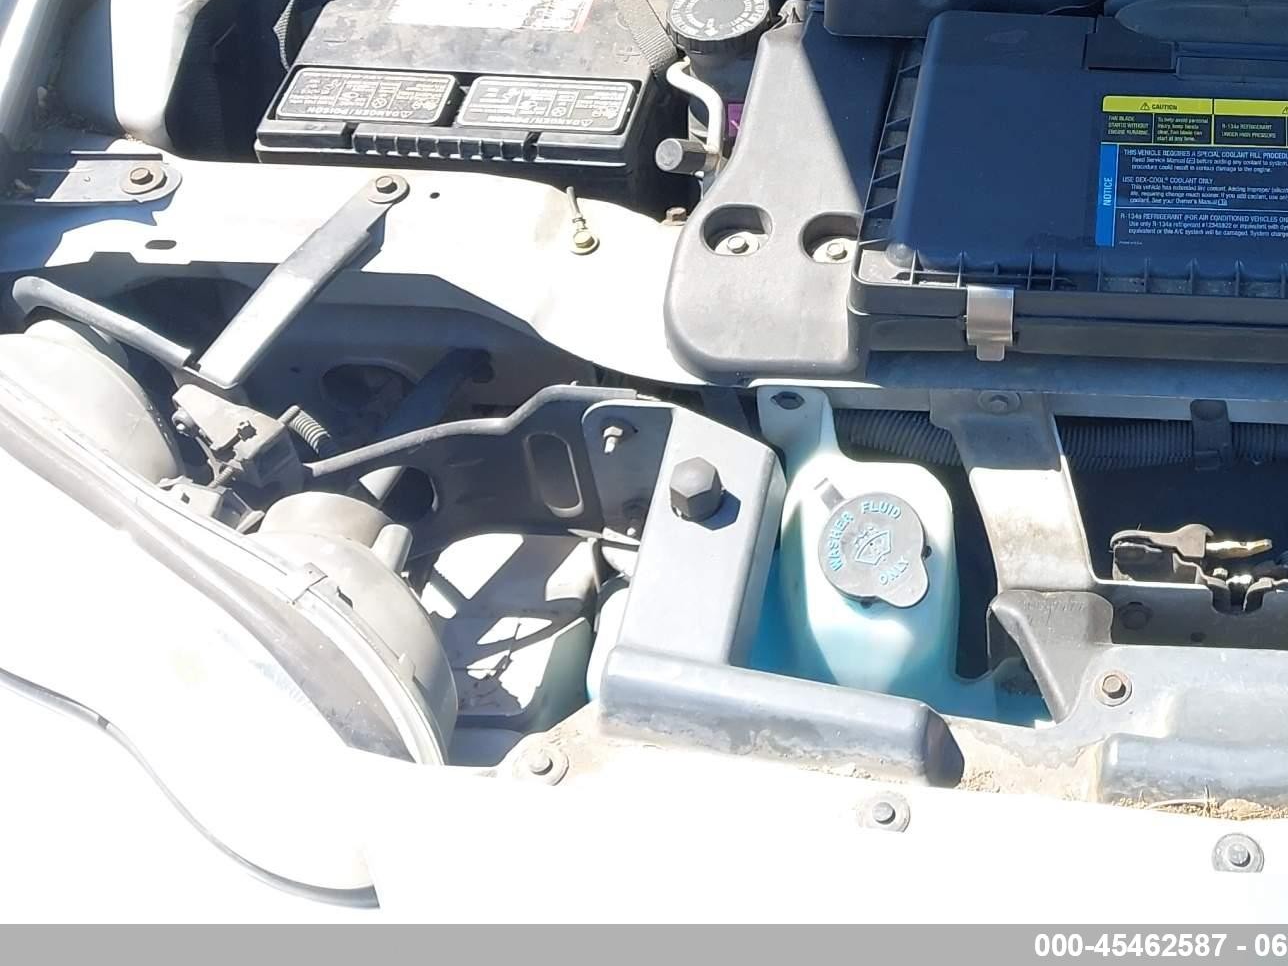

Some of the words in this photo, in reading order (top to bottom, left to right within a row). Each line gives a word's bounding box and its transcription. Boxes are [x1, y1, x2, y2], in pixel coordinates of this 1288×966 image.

[1103, 177, 1113, 206] NOTICE
[1210, 214, 1250, 222] CONDITIONED
[1250, 215, 1278, 223] VEHICLES
[861, 501, 901, 520] FLUID
[828, 511, 854, 572] WASHER
[880, 556, 909, 585] ONLY
